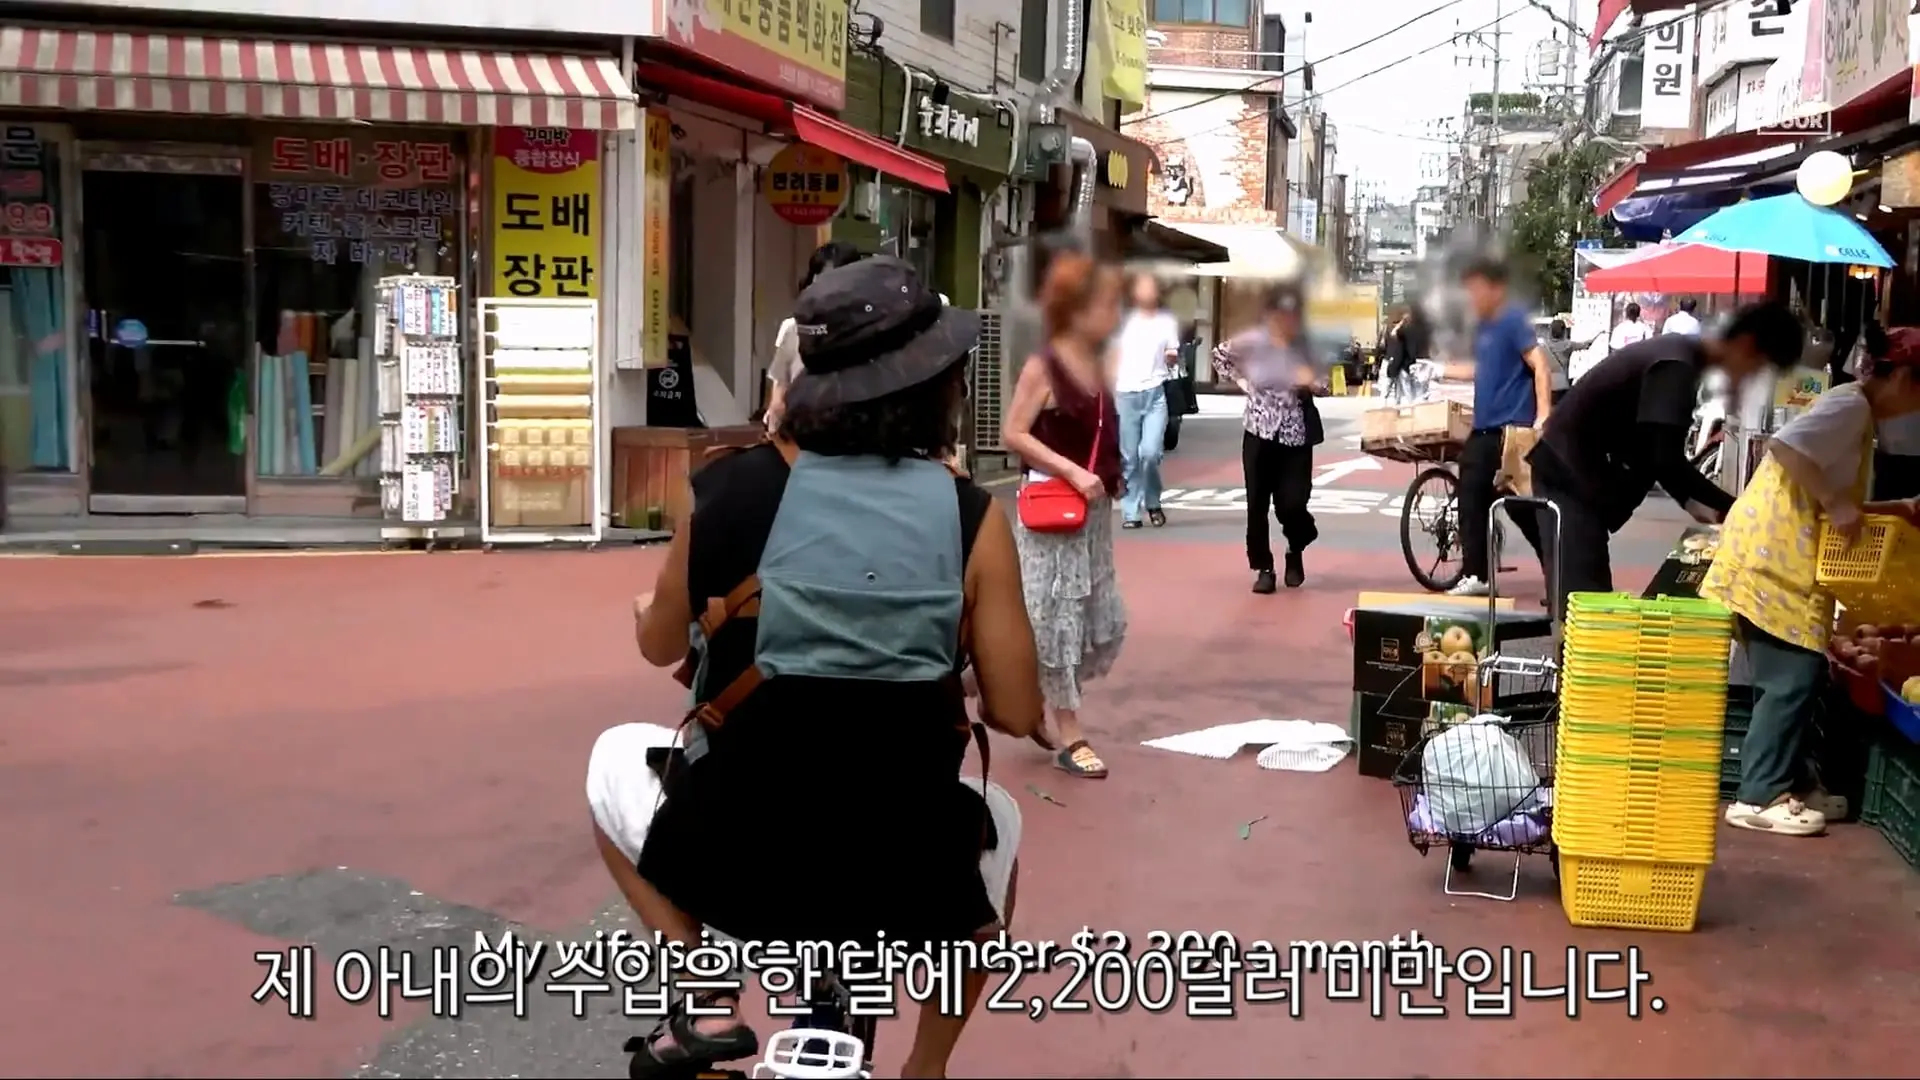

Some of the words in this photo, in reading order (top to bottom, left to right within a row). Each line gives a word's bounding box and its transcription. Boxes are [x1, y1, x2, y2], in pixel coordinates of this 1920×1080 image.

[723, 0, 844, 68] 용품백화점
[502, 193, 590, 236] 도배
[503, 254, 593, 297] 장판
